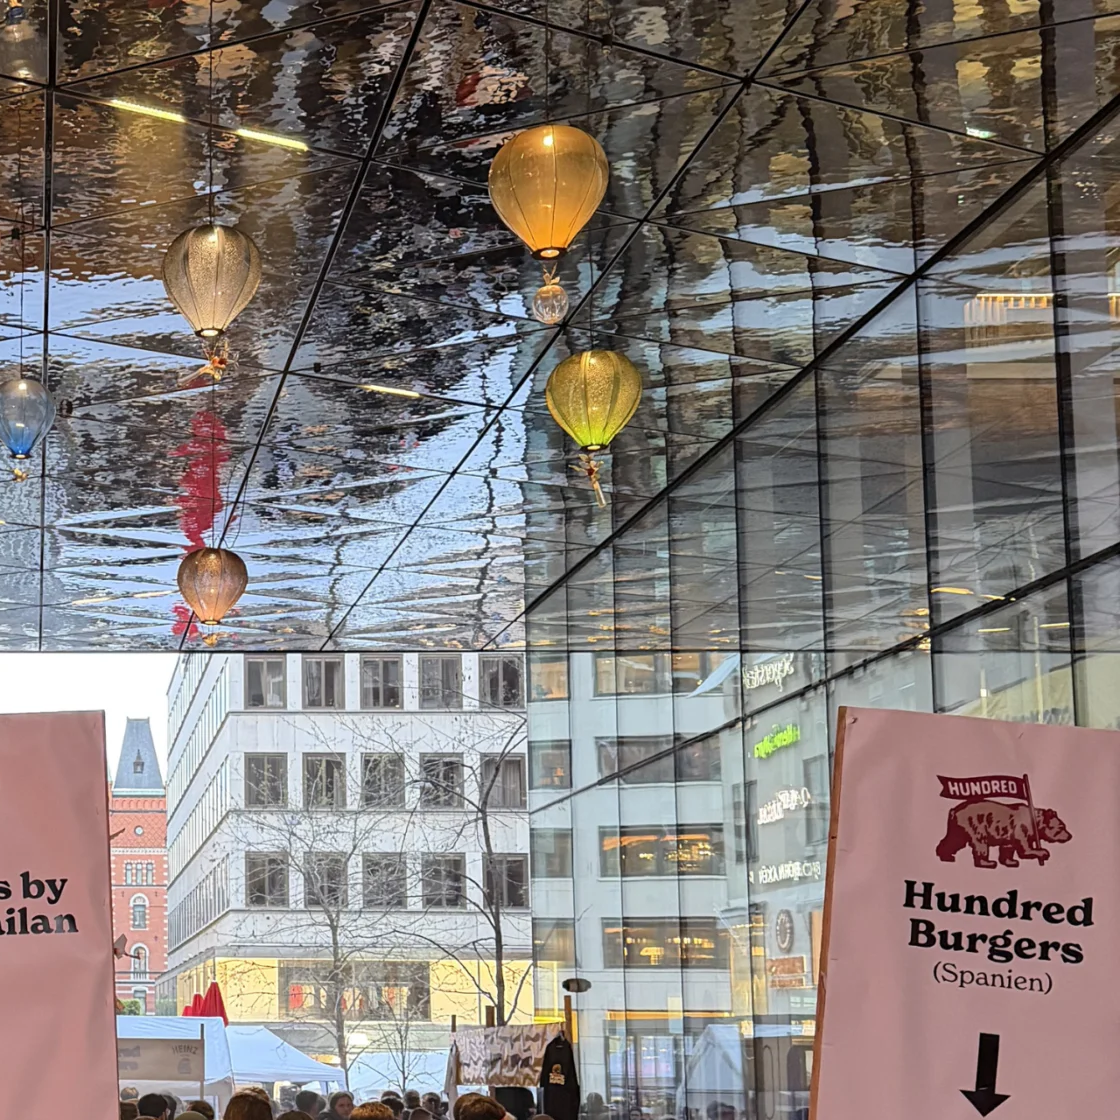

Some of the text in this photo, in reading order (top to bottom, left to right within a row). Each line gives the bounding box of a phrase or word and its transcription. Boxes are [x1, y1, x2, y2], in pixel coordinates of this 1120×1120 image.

[947, 780, 1018, 797] HUNDRED
[20, 871, 68, 904] by
[903, 880, 1094, 927] Hundred
[907, 918, 1084, 964] Burgers
[933, 961, 1053, 995] (Spanien)
[172, 1044, 199, 1055] HEINZ
